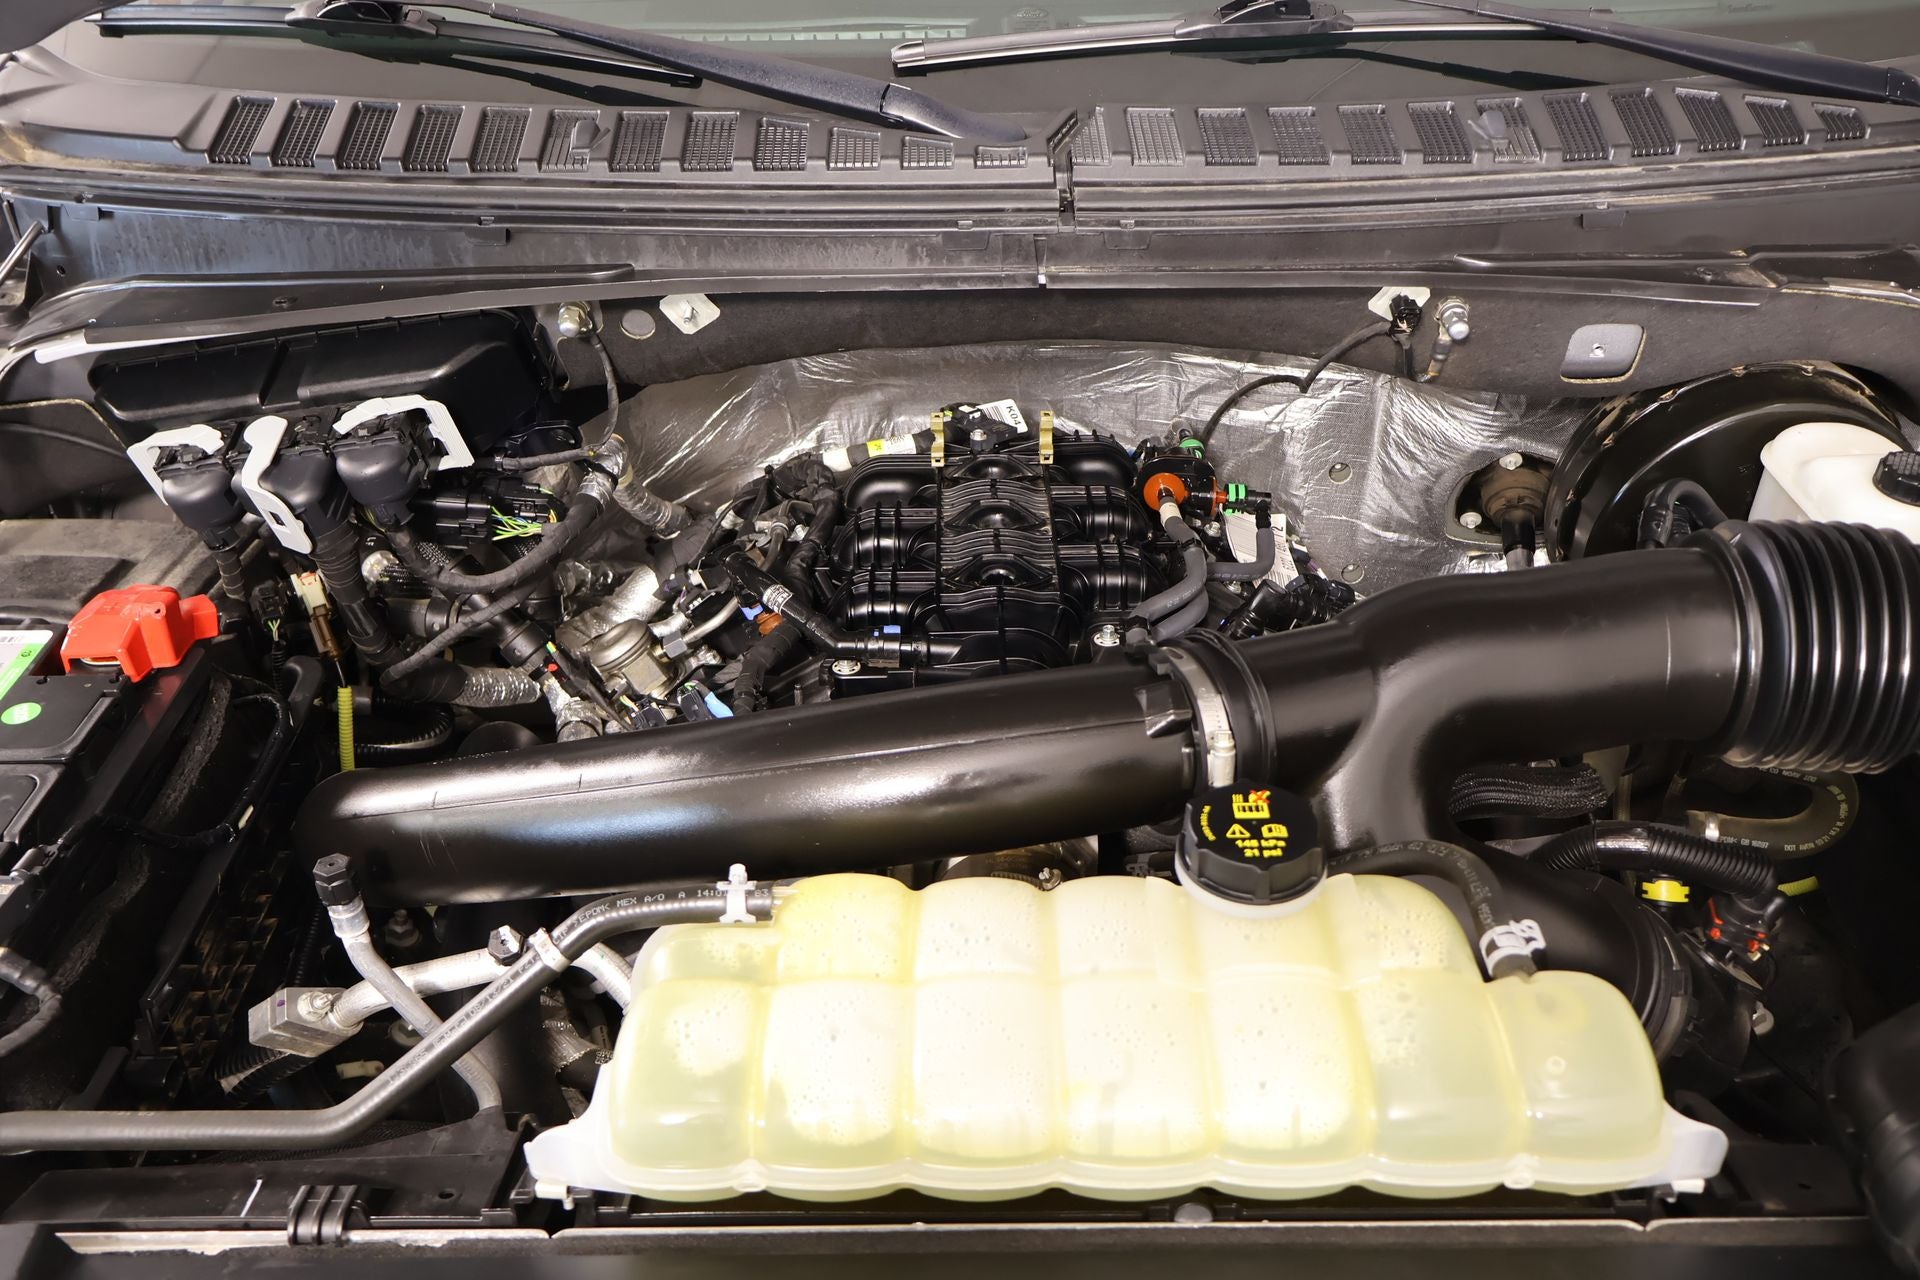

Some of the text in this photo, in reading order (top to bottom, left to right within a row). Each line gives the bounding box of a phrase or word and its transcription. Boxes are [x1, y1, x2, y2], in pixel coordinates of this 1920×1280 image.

[1243, 847, 1284, 858] 21 psi
[616, 896, 638, 908] MEX
